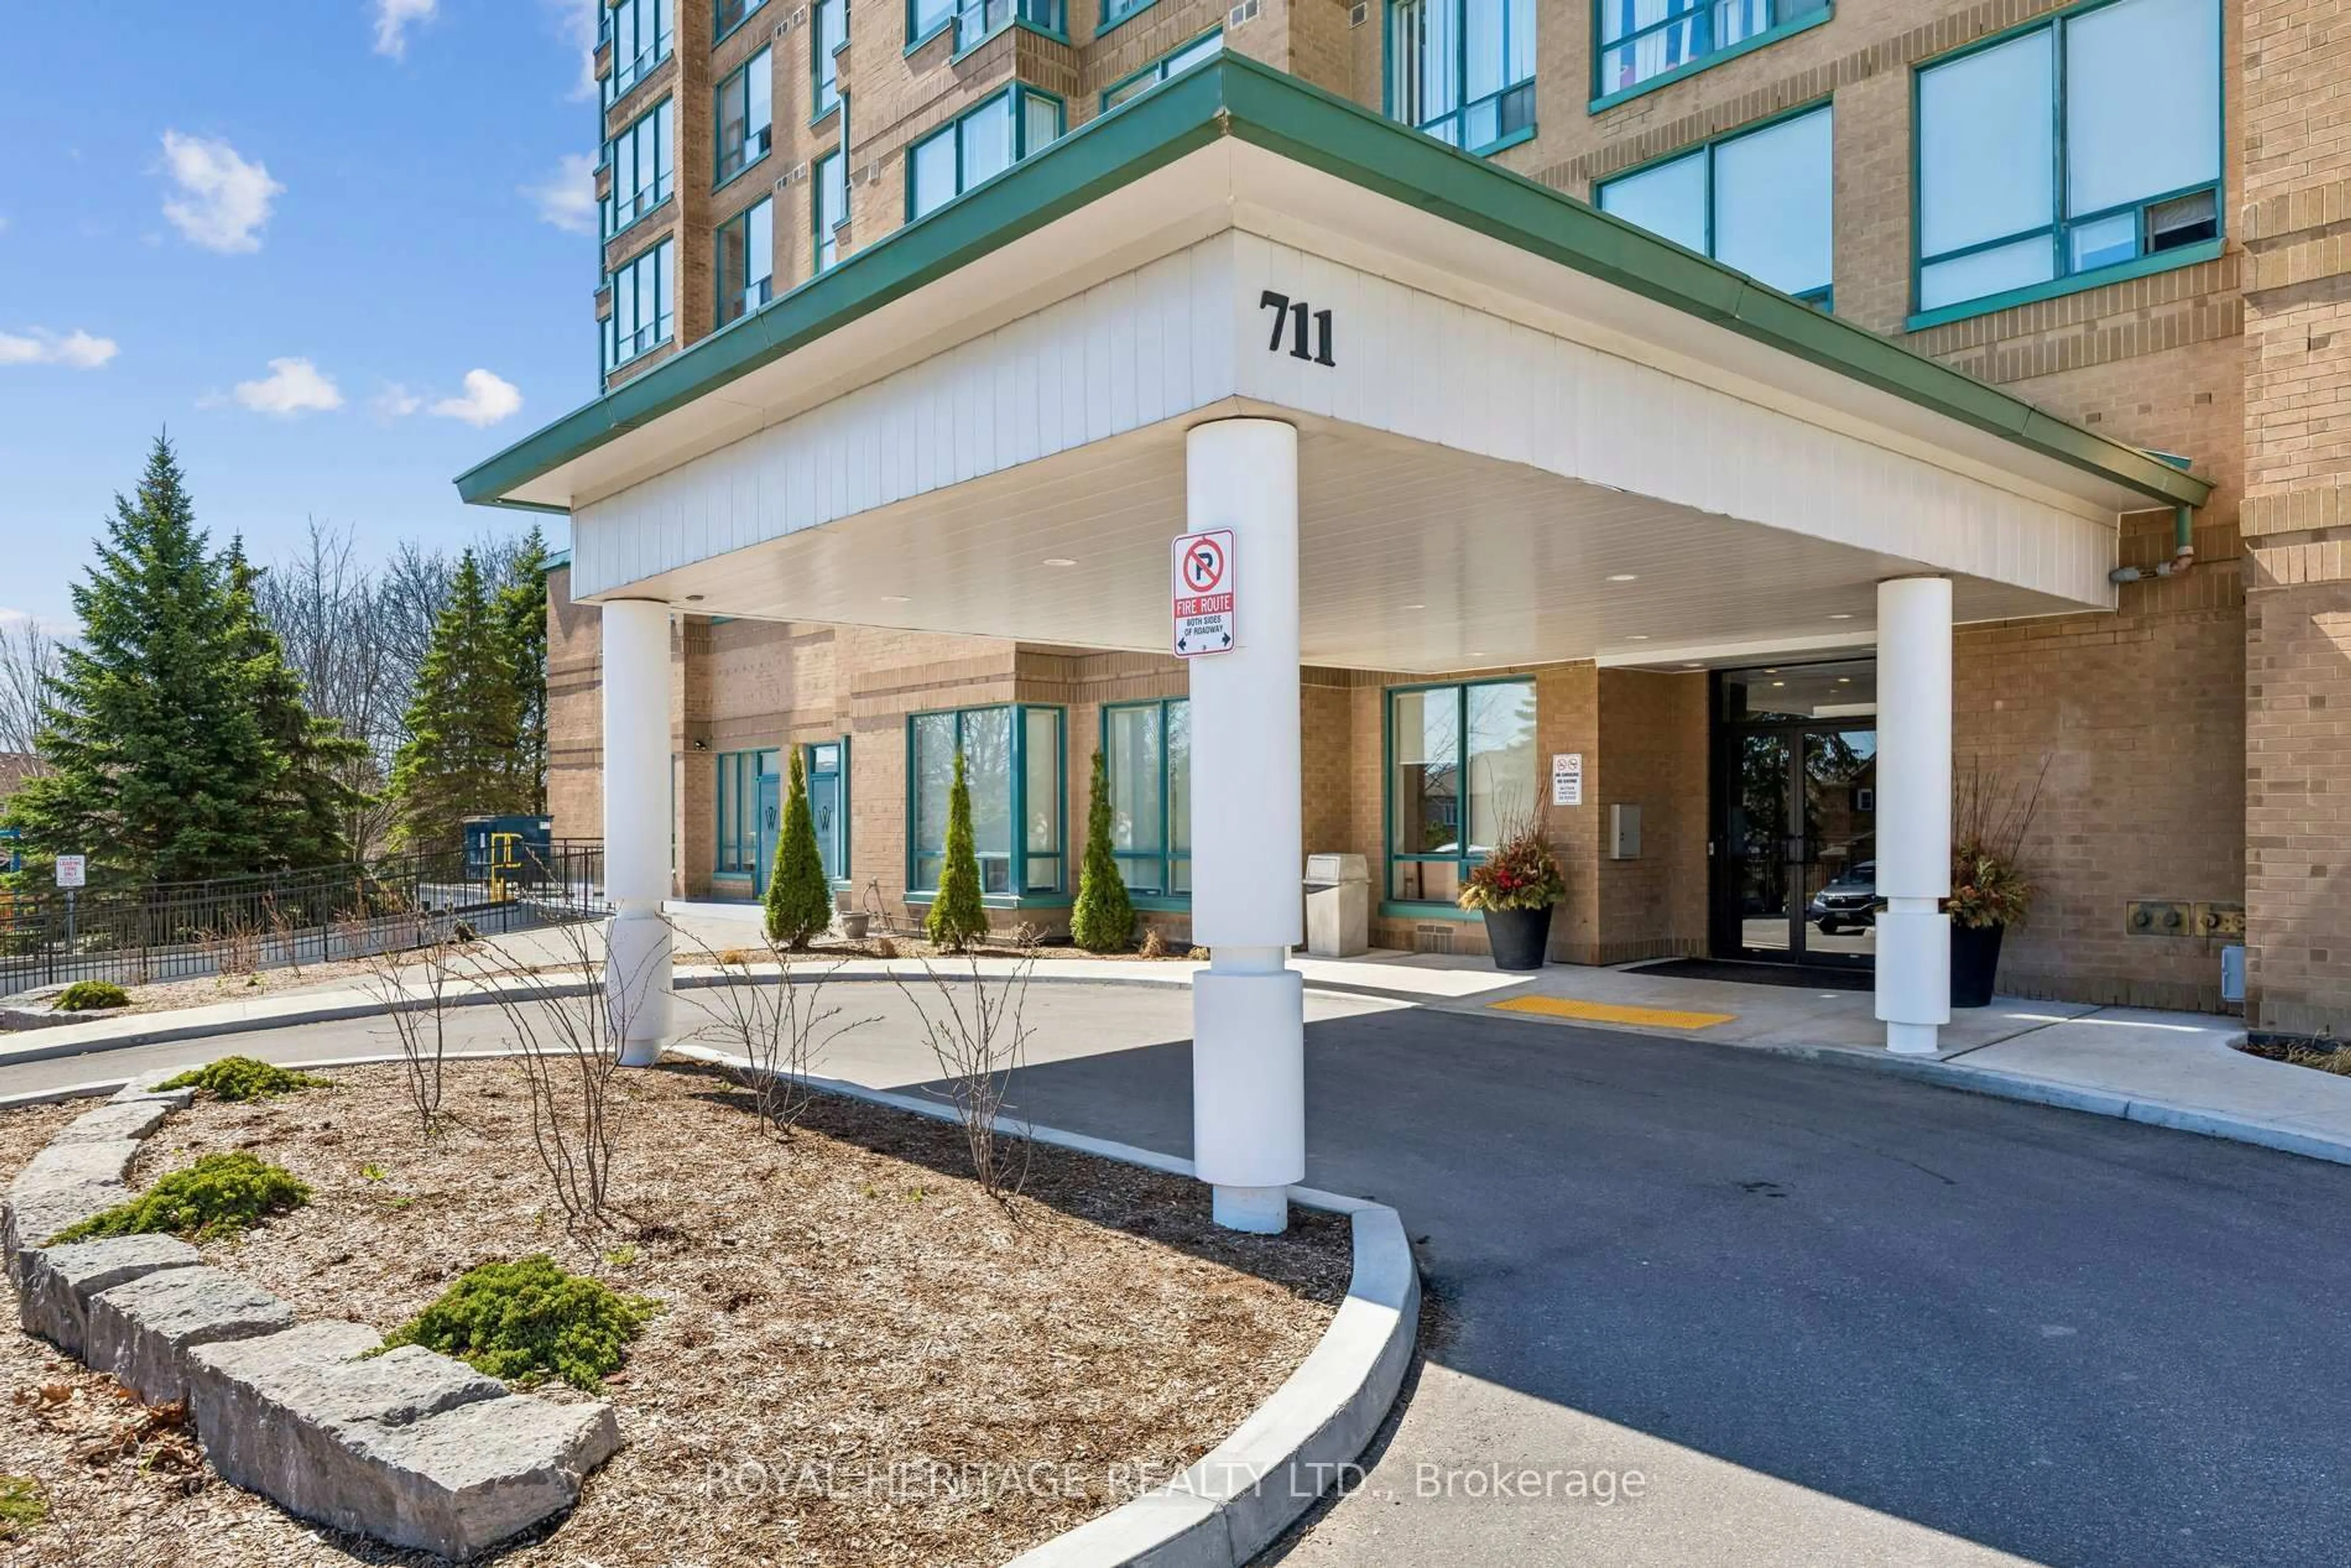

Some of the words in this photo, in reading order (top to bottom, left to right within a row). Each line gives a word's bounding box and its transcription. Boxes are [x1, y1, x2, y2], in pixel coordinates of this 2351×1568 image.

[1259, 290, 1336, 367] 711
[1177, 599, 1197, 617] FIRE
[1201, 595, 1231, 613] ROUTE
[1187, 617, 1202, 626] BOTH
[1204, 615, 1221, 625] SIDES
[1184, 628, 1191, 636] OF
[1194, 625, 1223, 635] ROADWAY
